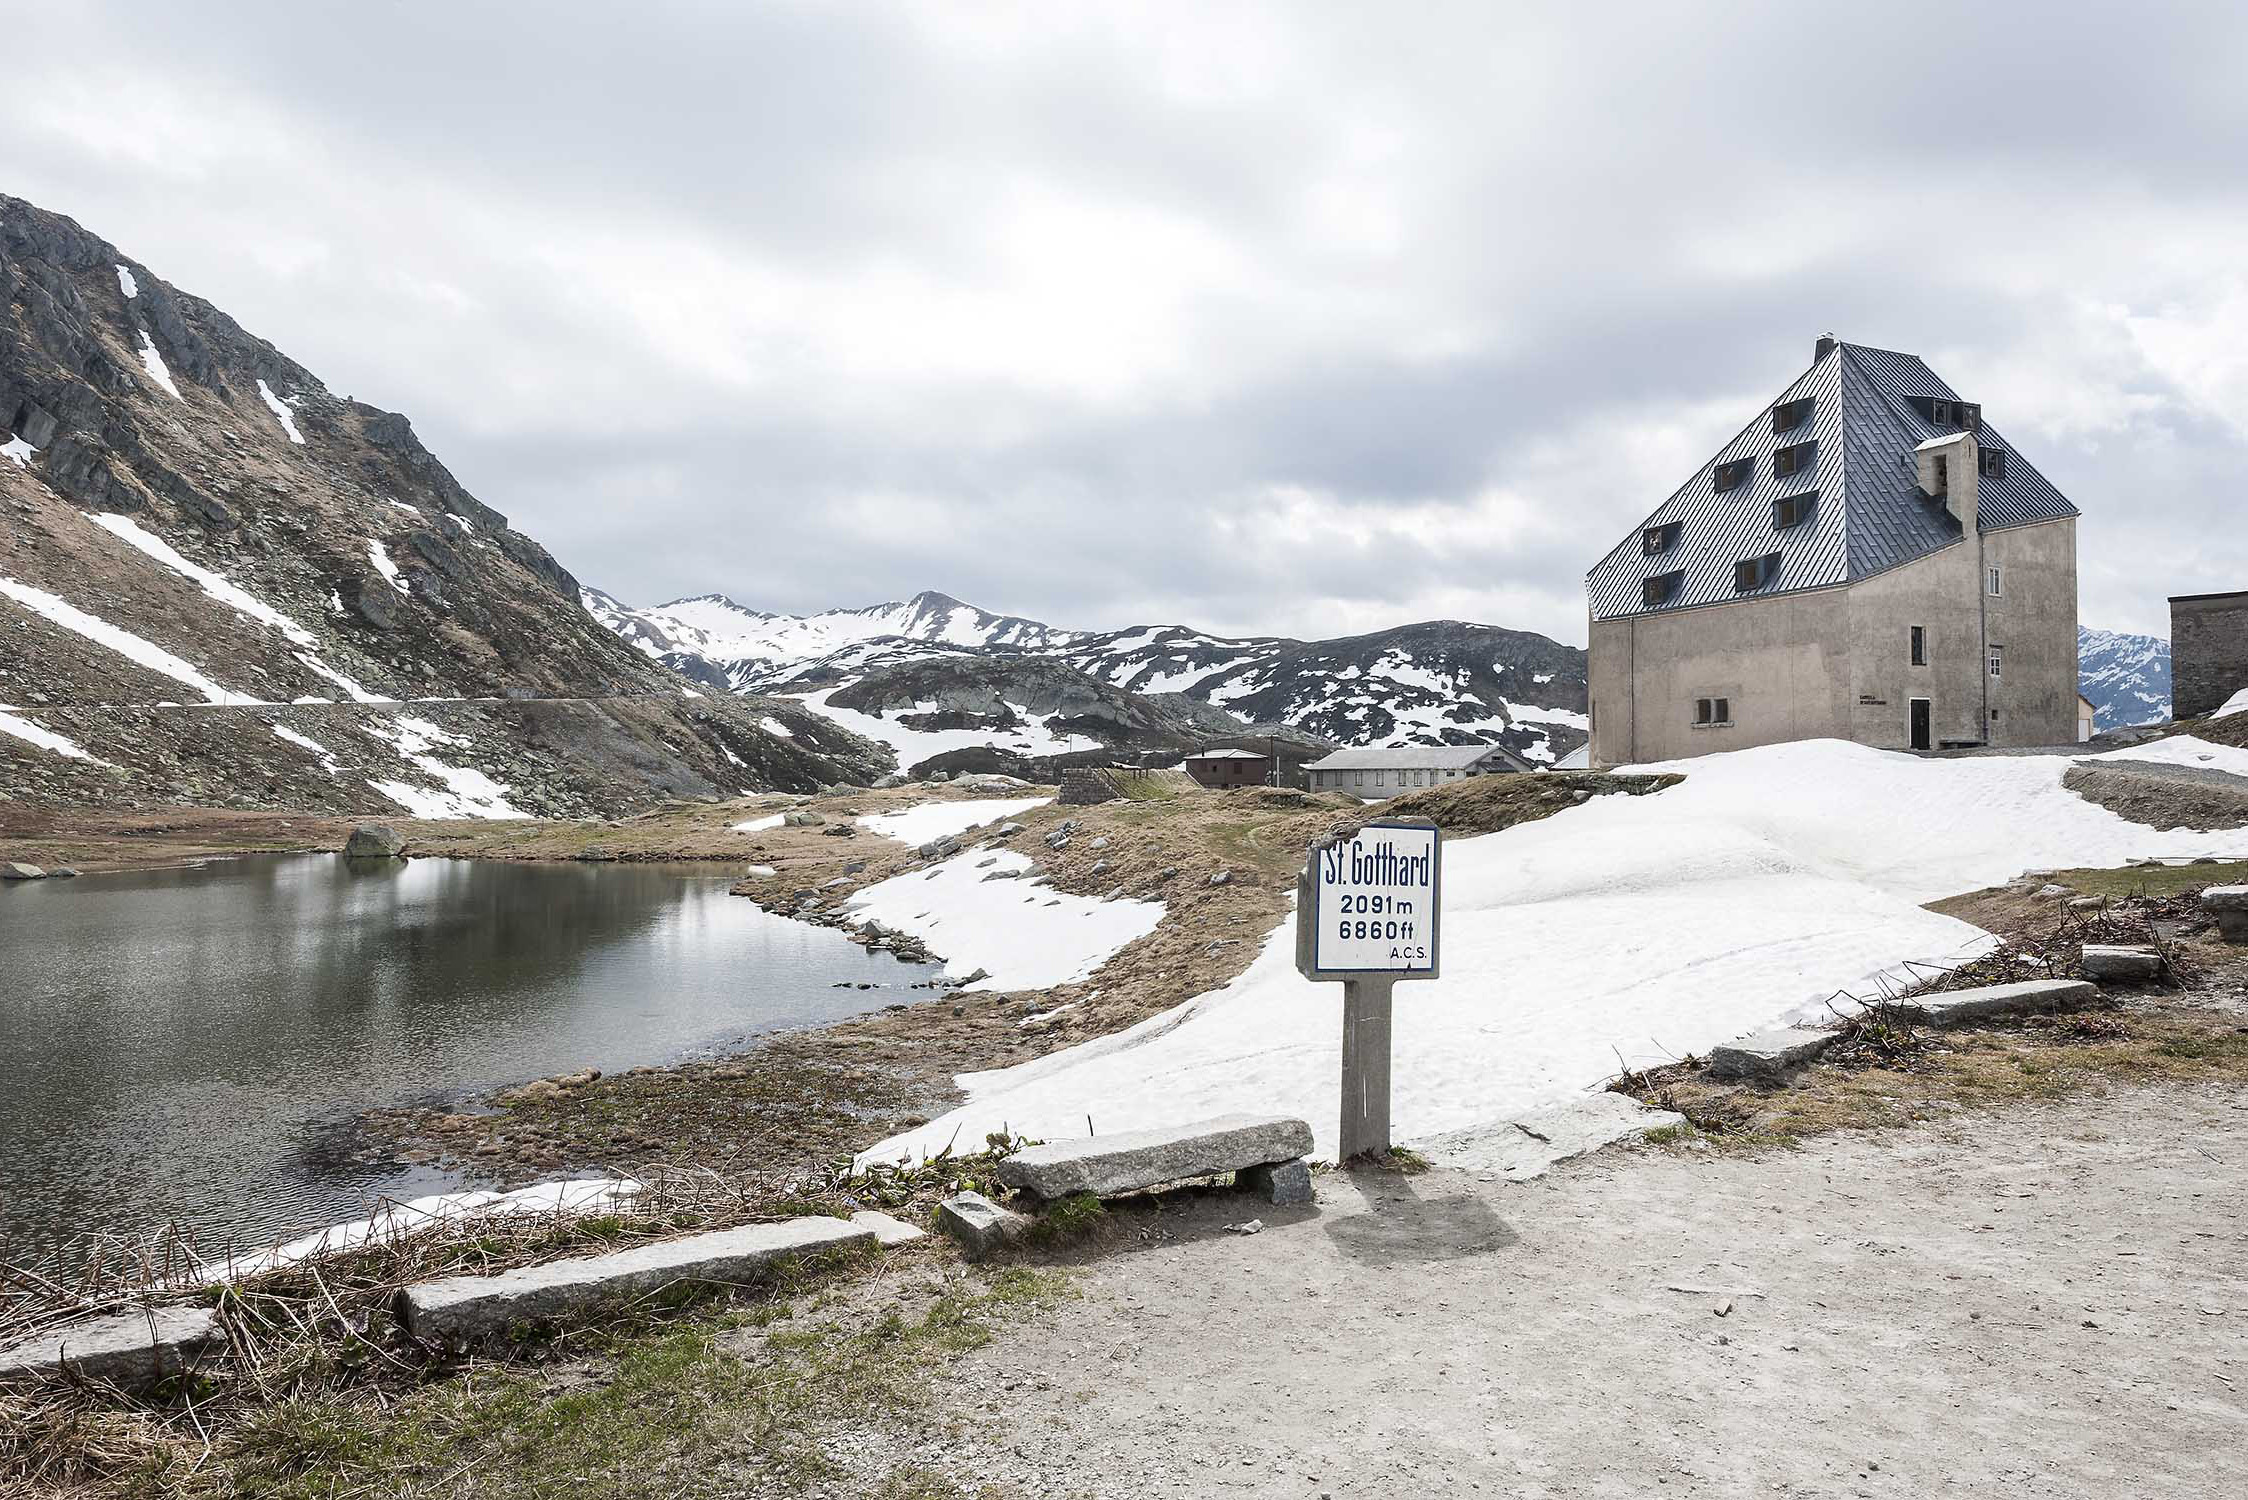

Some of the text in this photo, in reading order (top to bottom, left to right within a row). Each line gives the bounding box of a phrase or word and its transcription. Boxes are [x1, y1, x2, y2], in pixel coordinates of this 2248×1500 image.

[1325, 840, 1429, 887] St. Gotthard
[1339, 921, 1414, 940] 6860ft
[1390, 946, 1427, 959] A.C.S.
